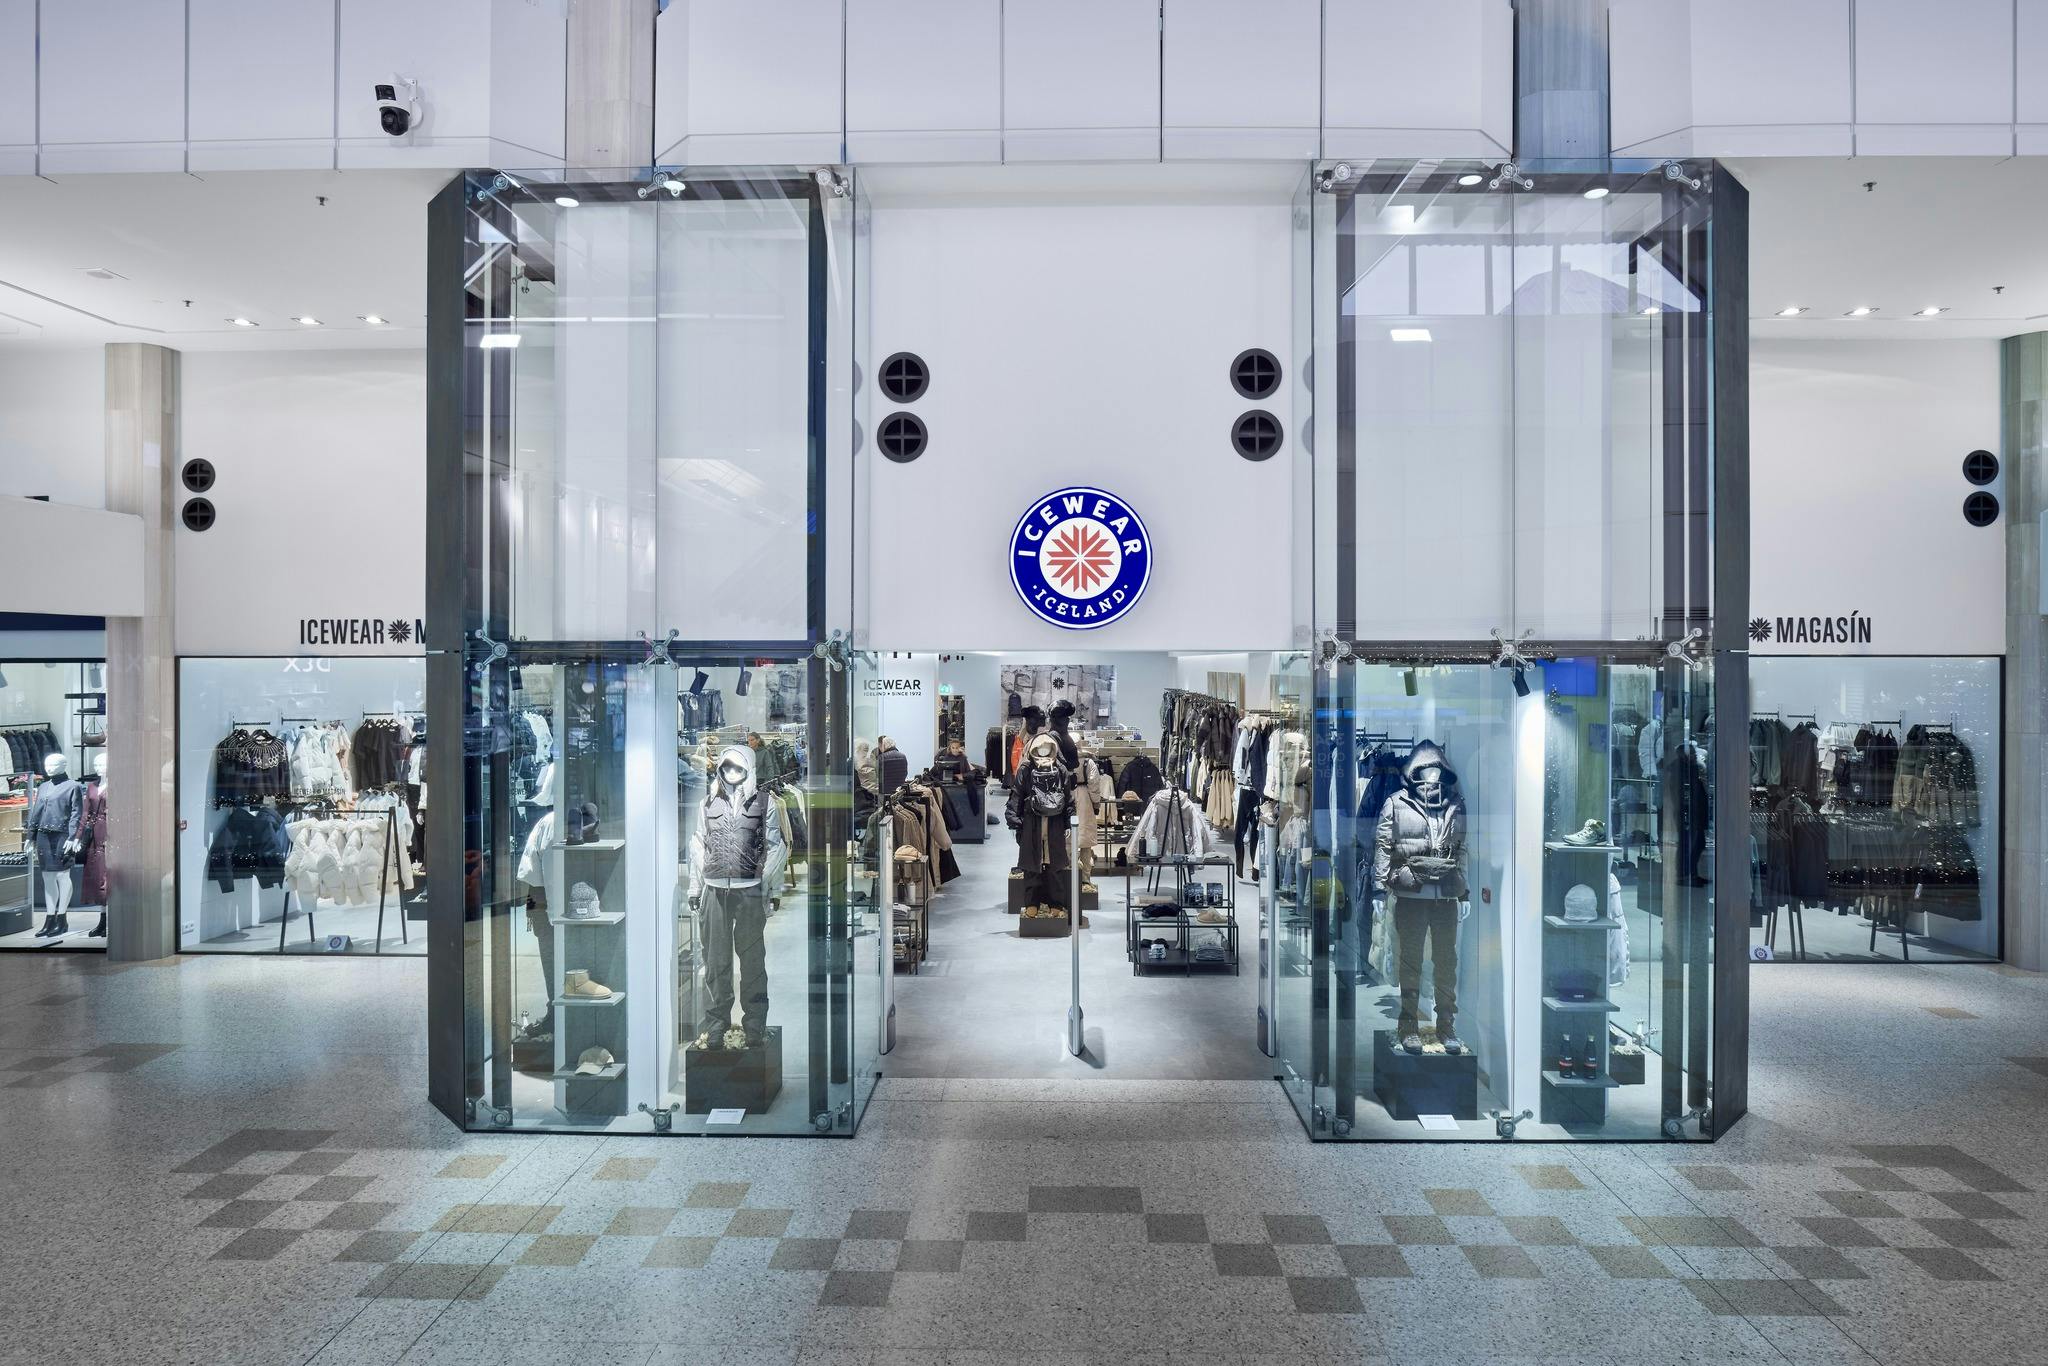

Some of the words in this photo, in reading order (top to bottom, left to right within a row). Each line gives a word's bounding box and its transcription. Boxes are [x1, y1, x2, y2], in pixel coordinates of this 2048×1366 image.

[1018, 495, 1142, 557] ICEWEAR
[1034, 588, 1125, 618] ICELAND
[300, 618, 385, 645] ICEWEAR
[1776, 610, 1871, 643] MAGASÍN
[863, 679, 921, 690] ICEWEAR
